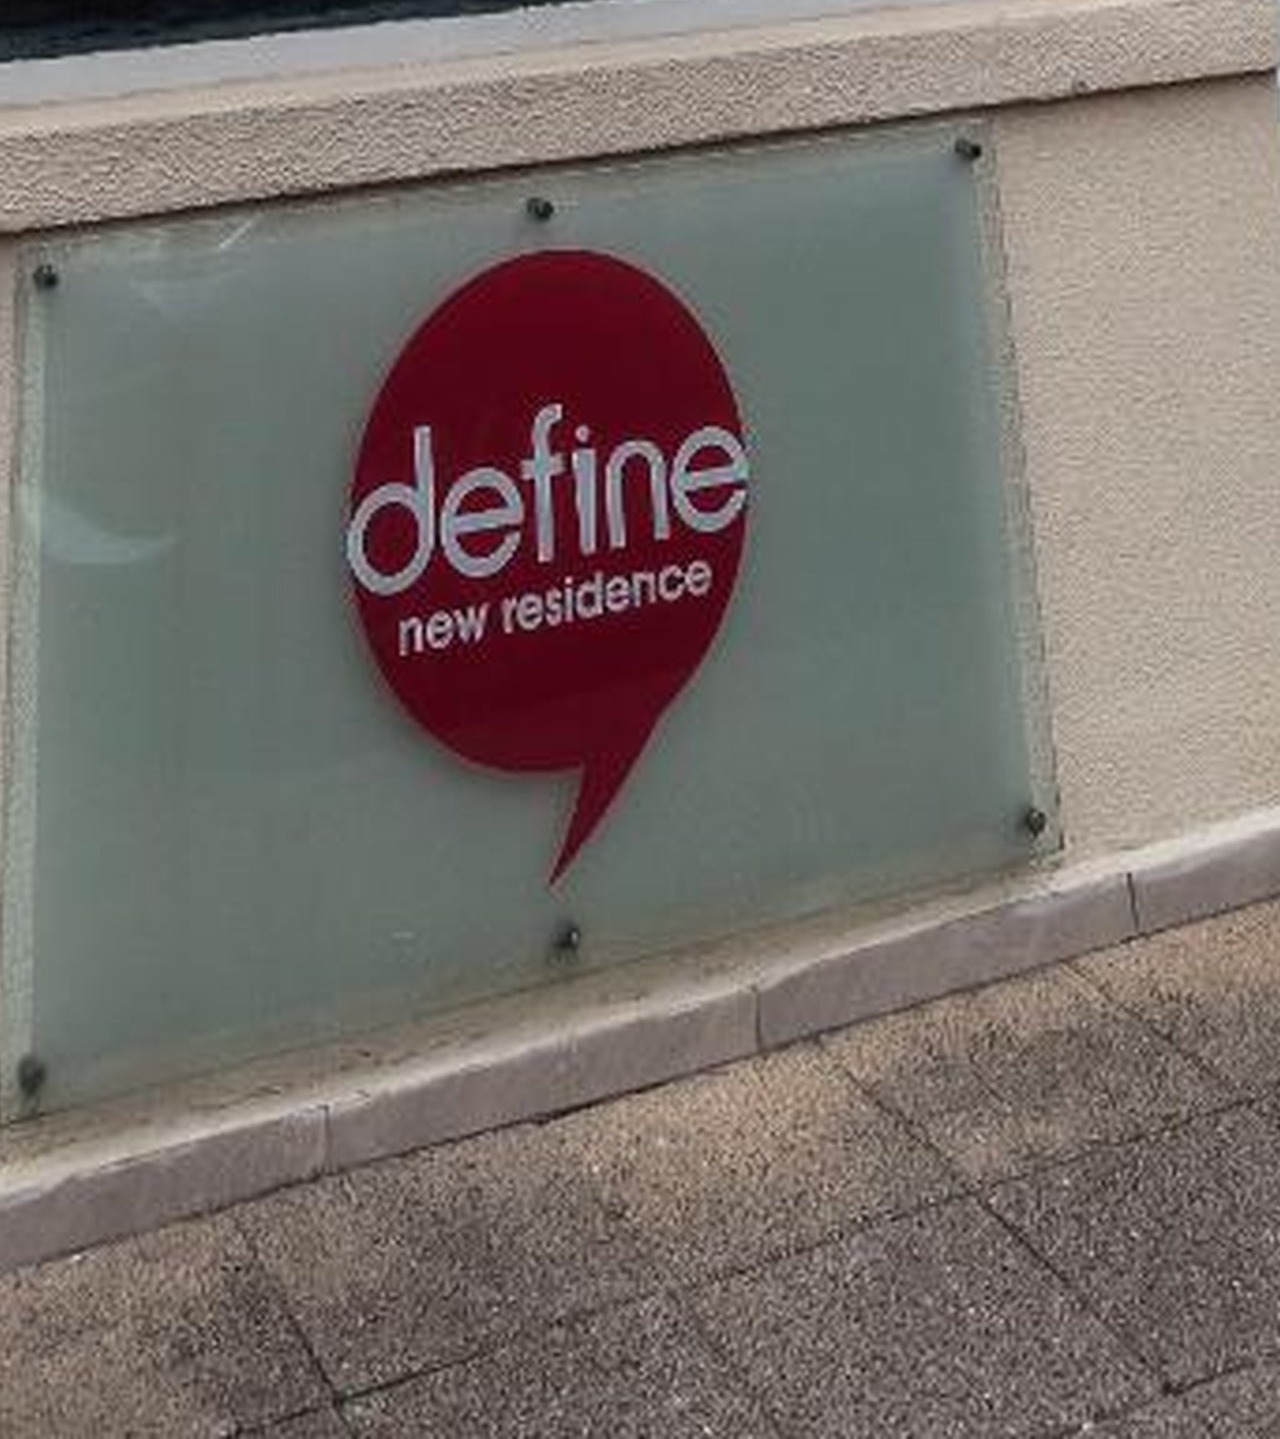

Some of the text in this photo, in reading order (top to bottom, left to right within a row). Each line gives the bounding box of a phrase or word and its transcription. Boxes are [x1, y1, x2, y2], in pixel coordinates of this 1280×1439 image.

[345, 401, 752, 597] define
[397, 558, 713, 657] new residence
